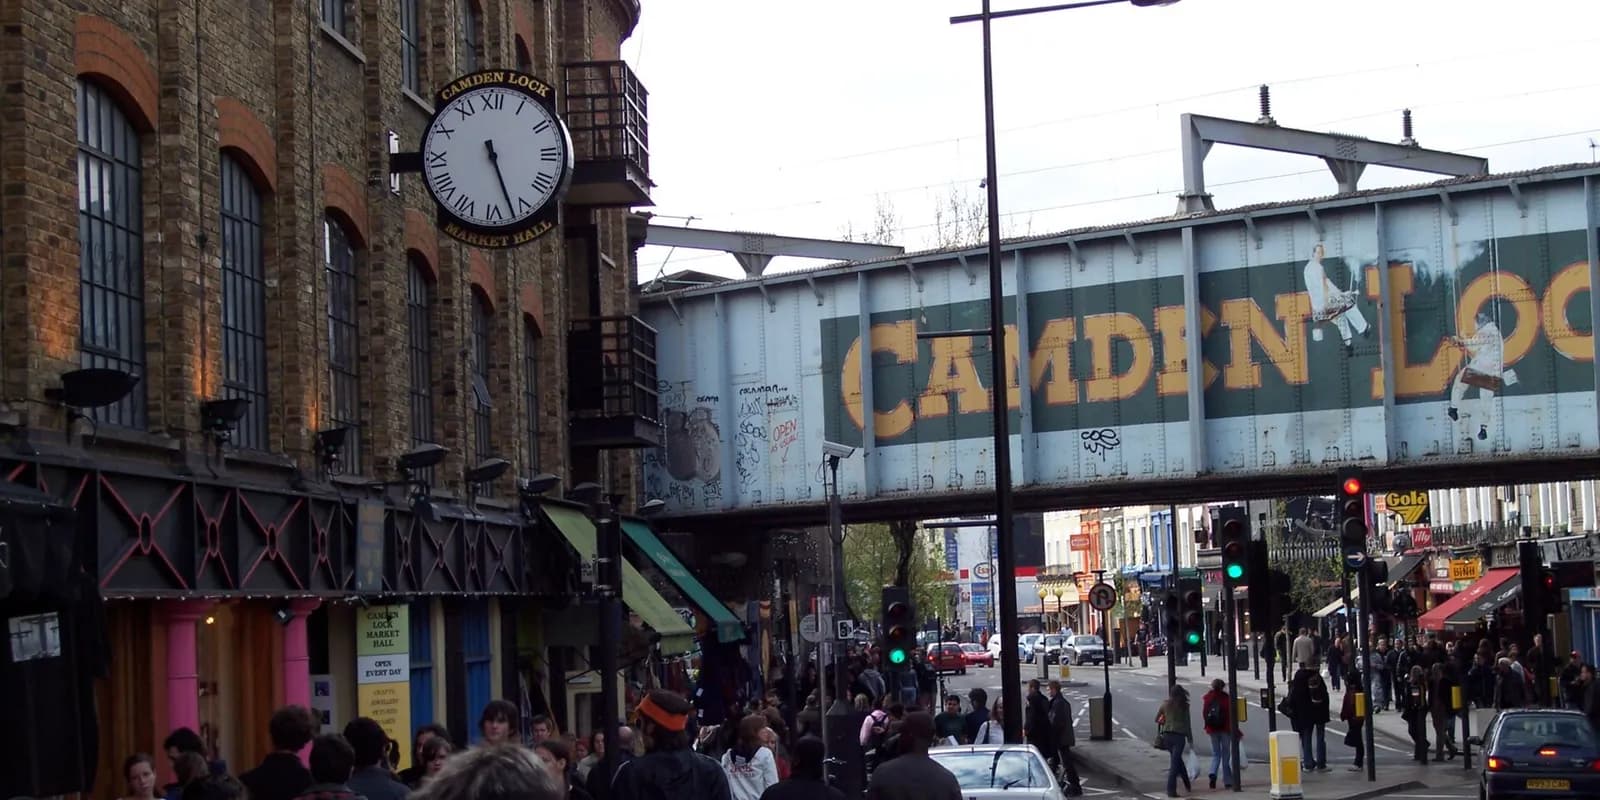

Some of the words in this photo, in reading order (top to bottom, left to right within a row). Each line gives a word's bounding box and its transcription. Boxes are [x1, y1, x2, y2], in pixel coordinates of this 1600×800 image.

[441, 71, 505, 100] CAMDEN
[508, 72, 551, 97] LOCK
[454, 99, 476, 121] XI
[481, 94, 504, 111] XII
[515, 100, 526, 115] I
[436, 123, 455, 139] X
[532, 120, 550, 134] II
[430, 151, 448, 169] IX
[540, 147, 557, 162] III
[453, 194, 474, 218] VII
[486, 204, 503, 221] VI
[518, 197, 532, 214] V
[446, 223, 509, 246] MARKET
[513, 220, 552, 244] HALL
[841, 291, 1314, 438] CAMDEN
[773, 418, 797, 442] OPEN
[1386, 490, 1428, 507] Gola
[1414, 531, 1431, 544] illy
[373, 620, 393, 629] LOCK
[366, 630, 400, 639] MARKET
[373, 639, 395, 648] HALL
[366, 669, 389, 677] EVERY
[389, 668, 402, 676] DAY
[374, 660, 392, 668] OPEN
